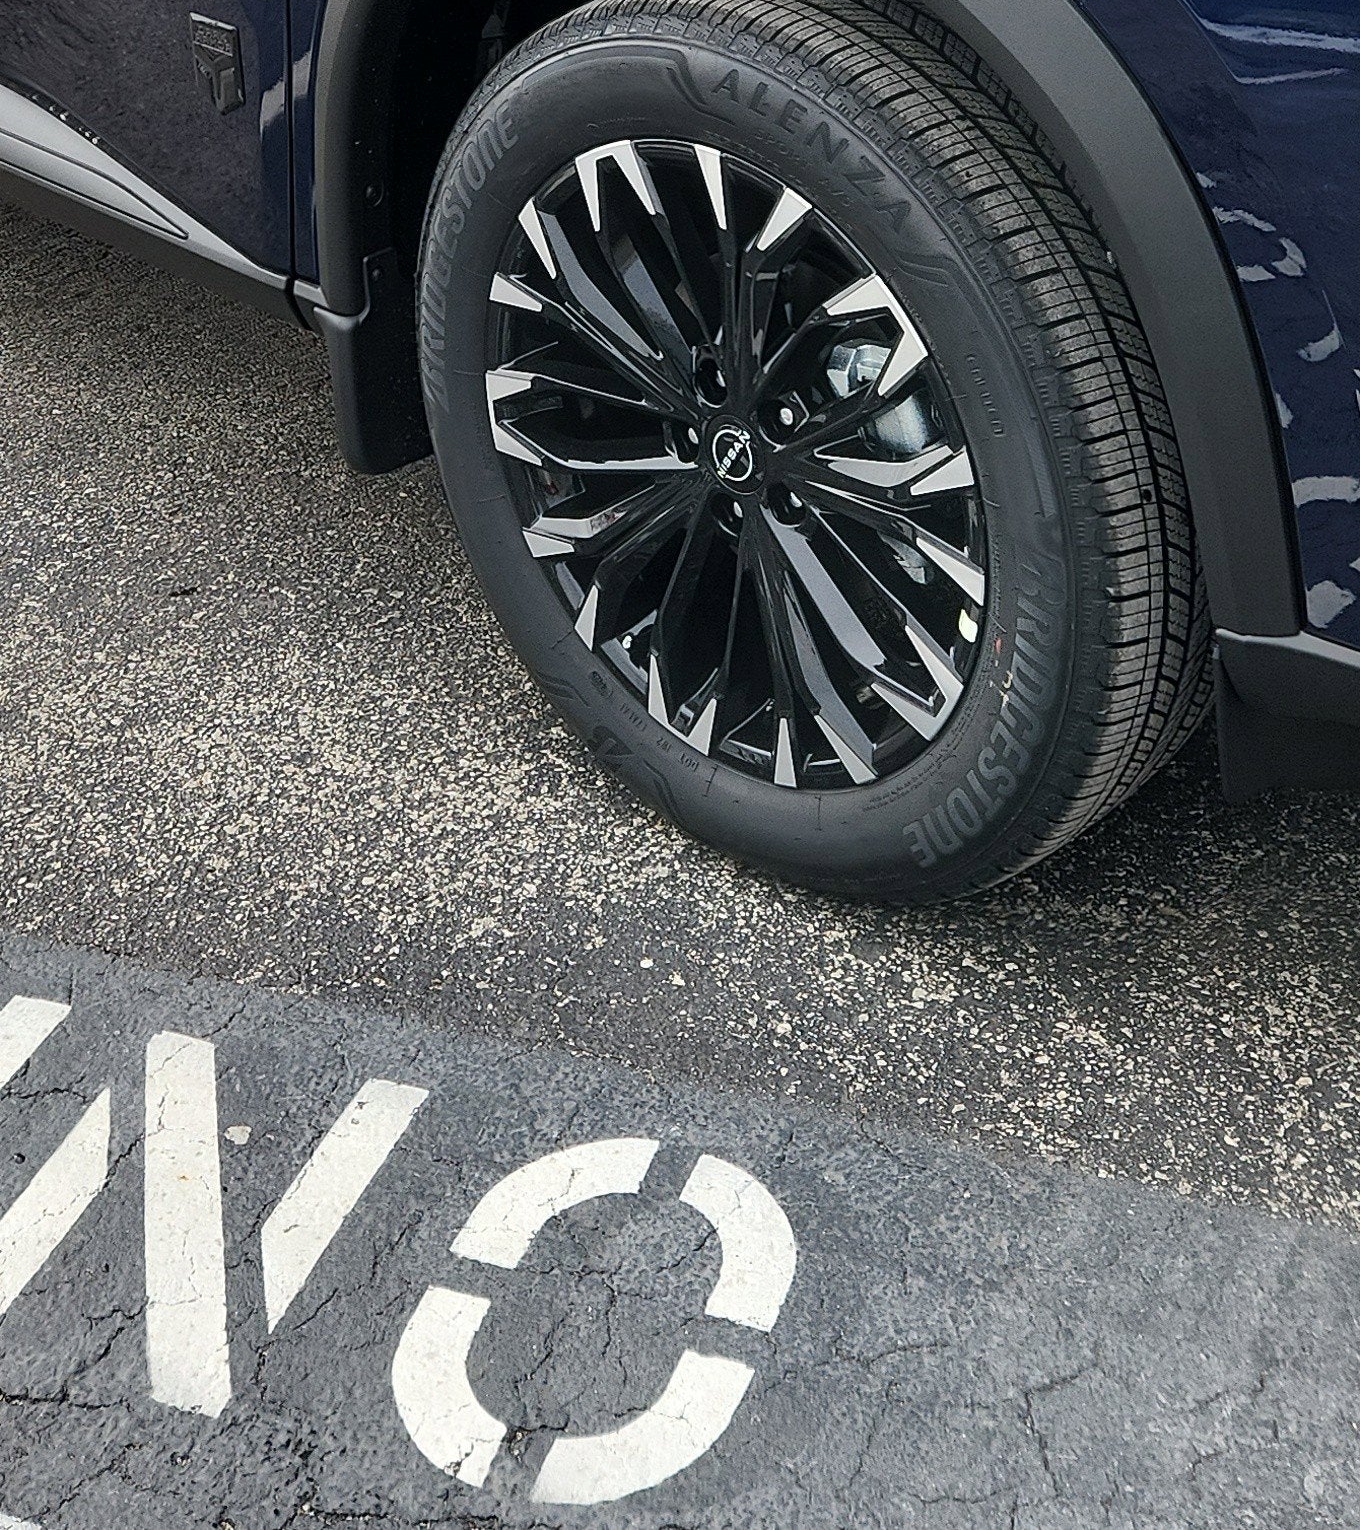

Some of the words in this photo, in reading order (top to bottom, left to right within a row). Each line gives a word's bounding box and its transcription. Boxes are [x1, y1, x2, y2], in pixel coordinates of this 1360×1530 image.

[420, 97, 520, 414] BRIDGESTONE
[710, 67, 913, 235] ALENZA
[717, 430, 751, 479] NISSAN
[902, 558, 1067, 869] BRIDGESTONE
